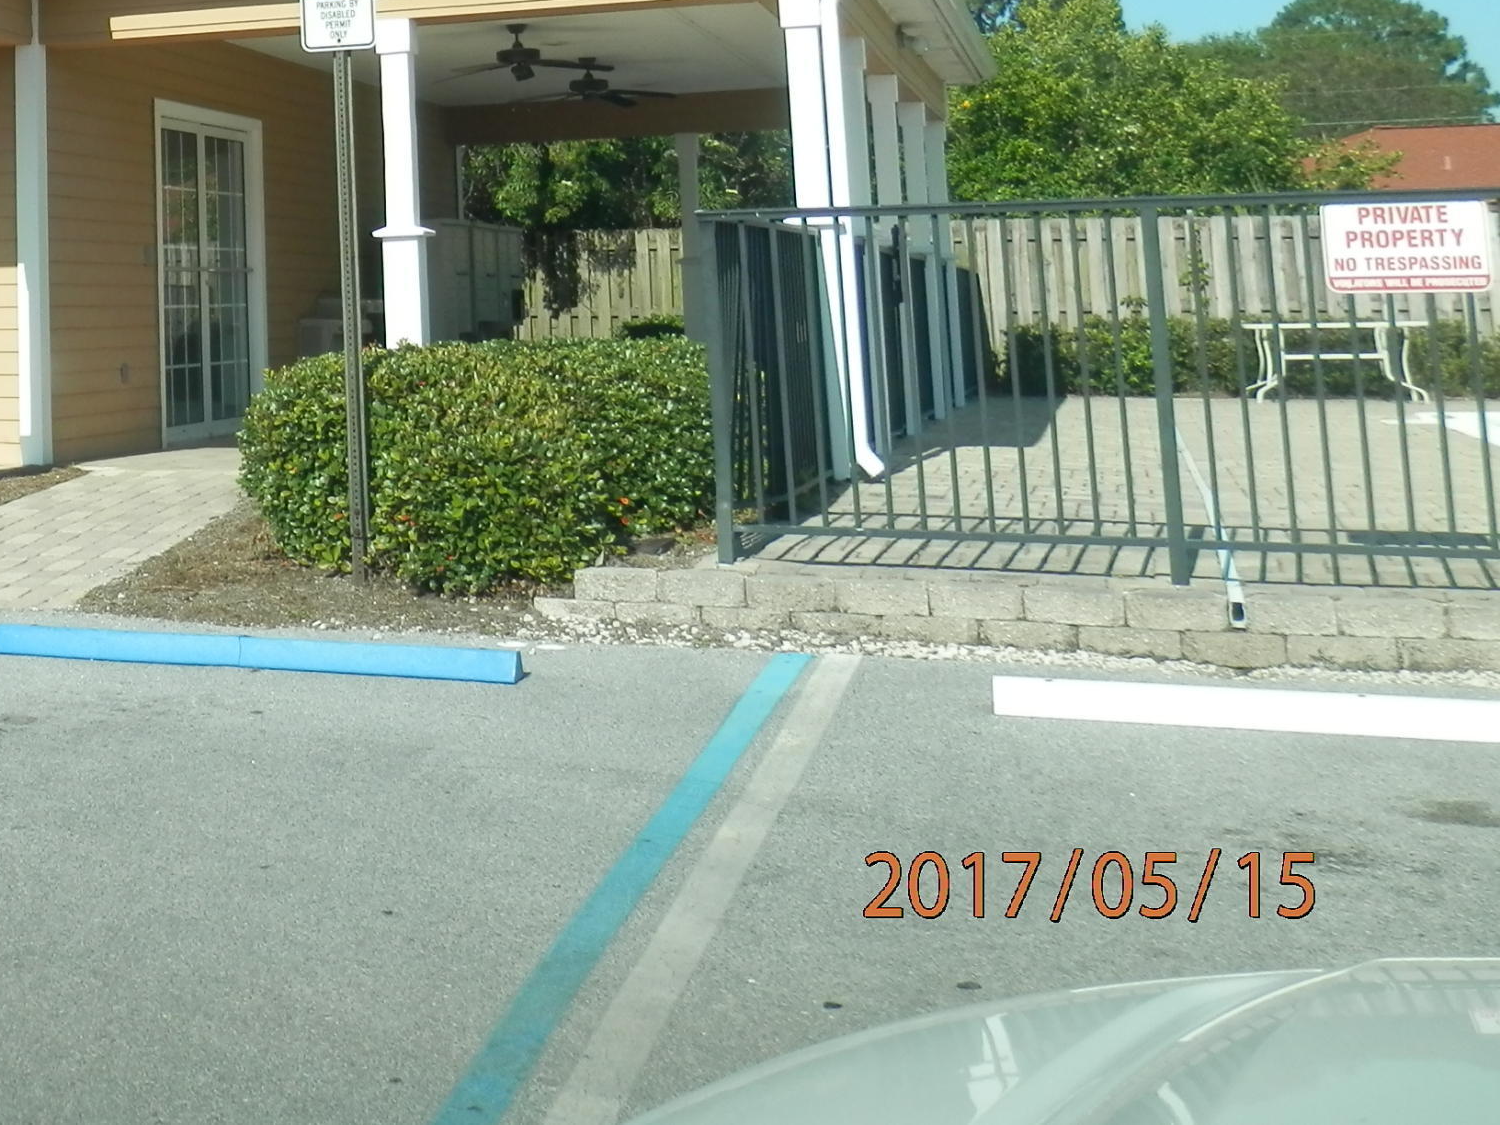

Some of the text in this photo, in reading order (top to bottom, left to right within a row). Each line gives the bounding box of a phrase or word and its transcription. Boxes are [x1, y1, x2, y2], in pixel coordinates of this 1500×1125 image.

[316, 0, 358, 9] PARKING BY
[320, 10, 356, 19] DISABLED
[325, 20, 351, 29] PERMIT
[330, 30, 347, 39] ONLY
[1358, 205, 1448, 225] PRIVATE
[1345, 228, 1464, 249] PROPERTY
[1334, 255, 1482, 271] NO TRESPASSING
